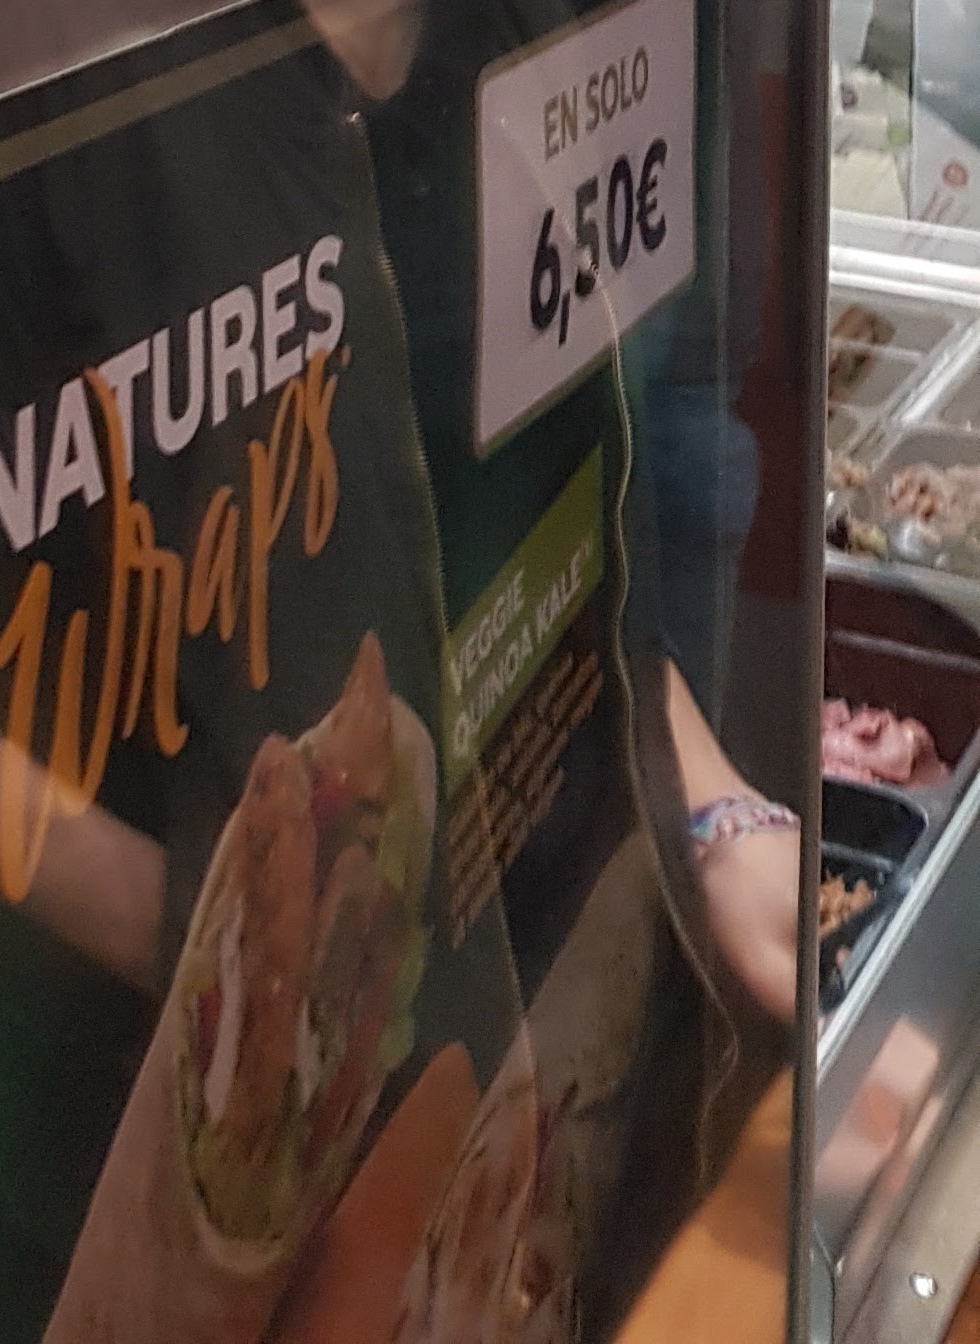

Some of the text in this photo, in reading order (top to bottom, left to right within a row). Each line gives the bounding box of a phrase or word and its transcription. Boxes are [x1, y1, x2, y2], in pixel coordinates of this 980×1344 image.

[541, 45, 650, 163] EN SOLO
[529, 137, 668, 349] 6,50€
[449, 568, 524, 698] VEGGIE
[452, 623, 534, 759] QUINOA
